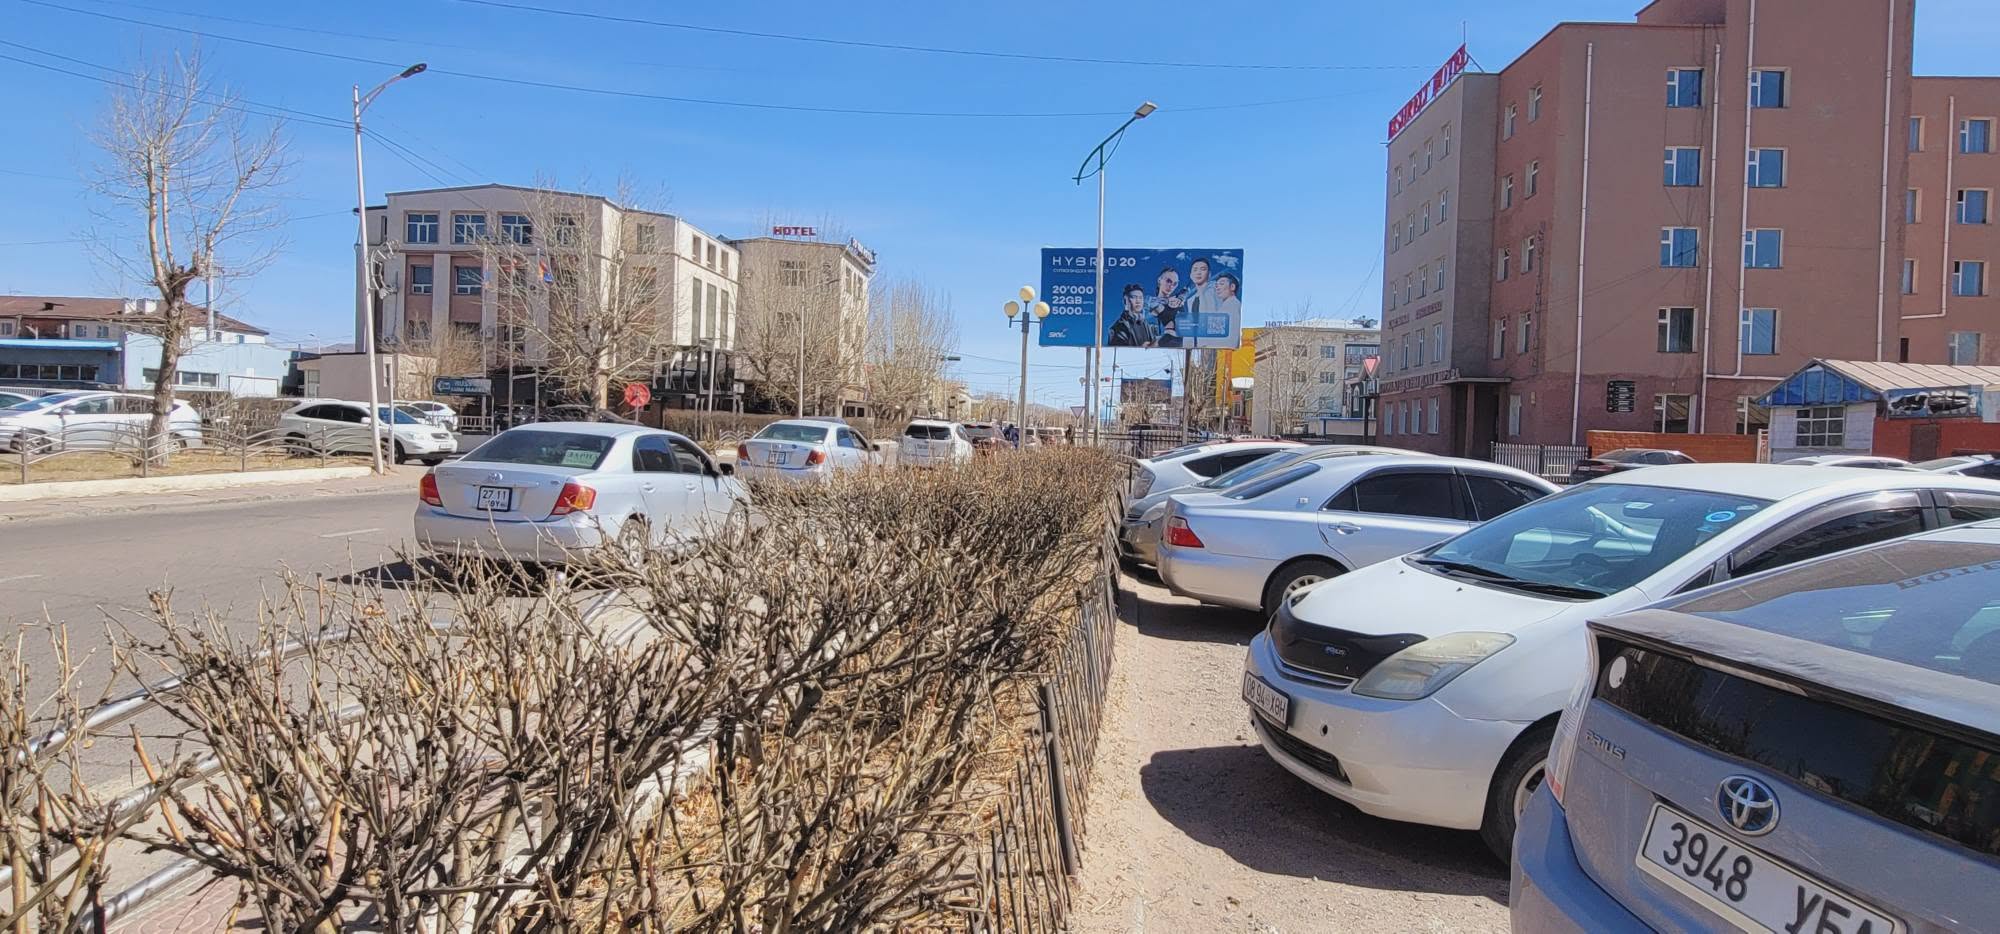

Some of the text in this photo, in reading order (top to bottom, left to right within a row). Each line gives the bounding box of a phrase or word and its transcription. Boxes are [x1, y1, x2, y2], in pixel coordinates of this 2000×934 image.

[773, 226, 817, 236] HOTEL
[1052, 256, 1136, 267] HYBRD 20
[1052, 295, 1083, 305] 22GB
[1052, 306, 1082, 316] 5000
[482, 489, 507, 500] 27 11
[1256, 683, 1265, 706] 94
[1586, 729, 1626, 761] PRIUS
[1662, 821, 1754, 903] 3948
